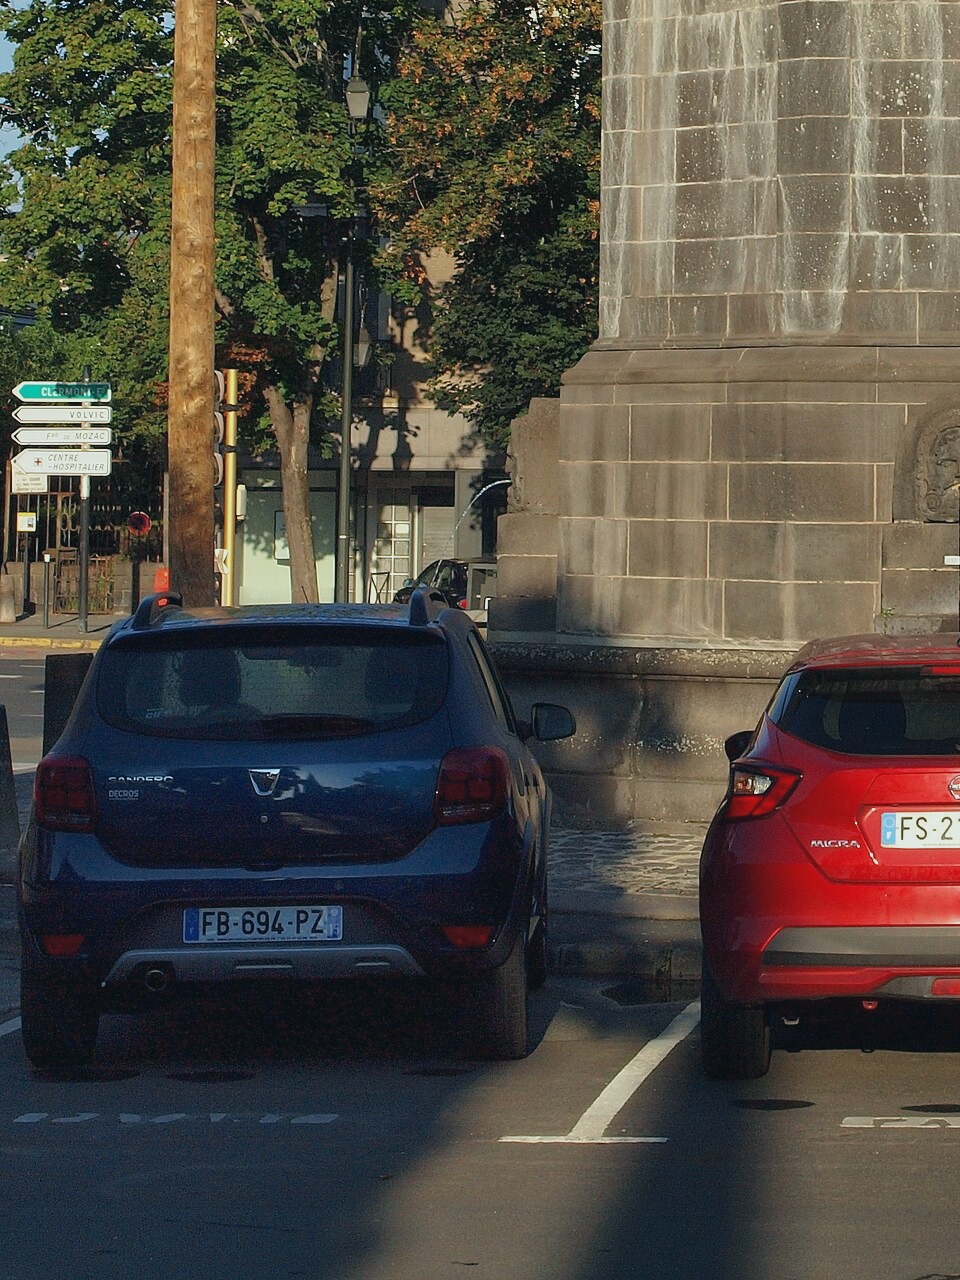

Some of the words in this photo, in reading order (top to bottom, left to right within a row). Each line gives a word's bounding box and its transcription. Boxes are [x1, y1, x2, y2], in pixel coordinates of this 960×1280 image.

[69, 411, 105, 419] VOLVIC
[74, 432, 105, 440] MOZAC
[47, 454, 79, 462] CENTRE
[810, 839, 861, 848] MICRA
[201, 909, 325, 937] FB-694-PZ
